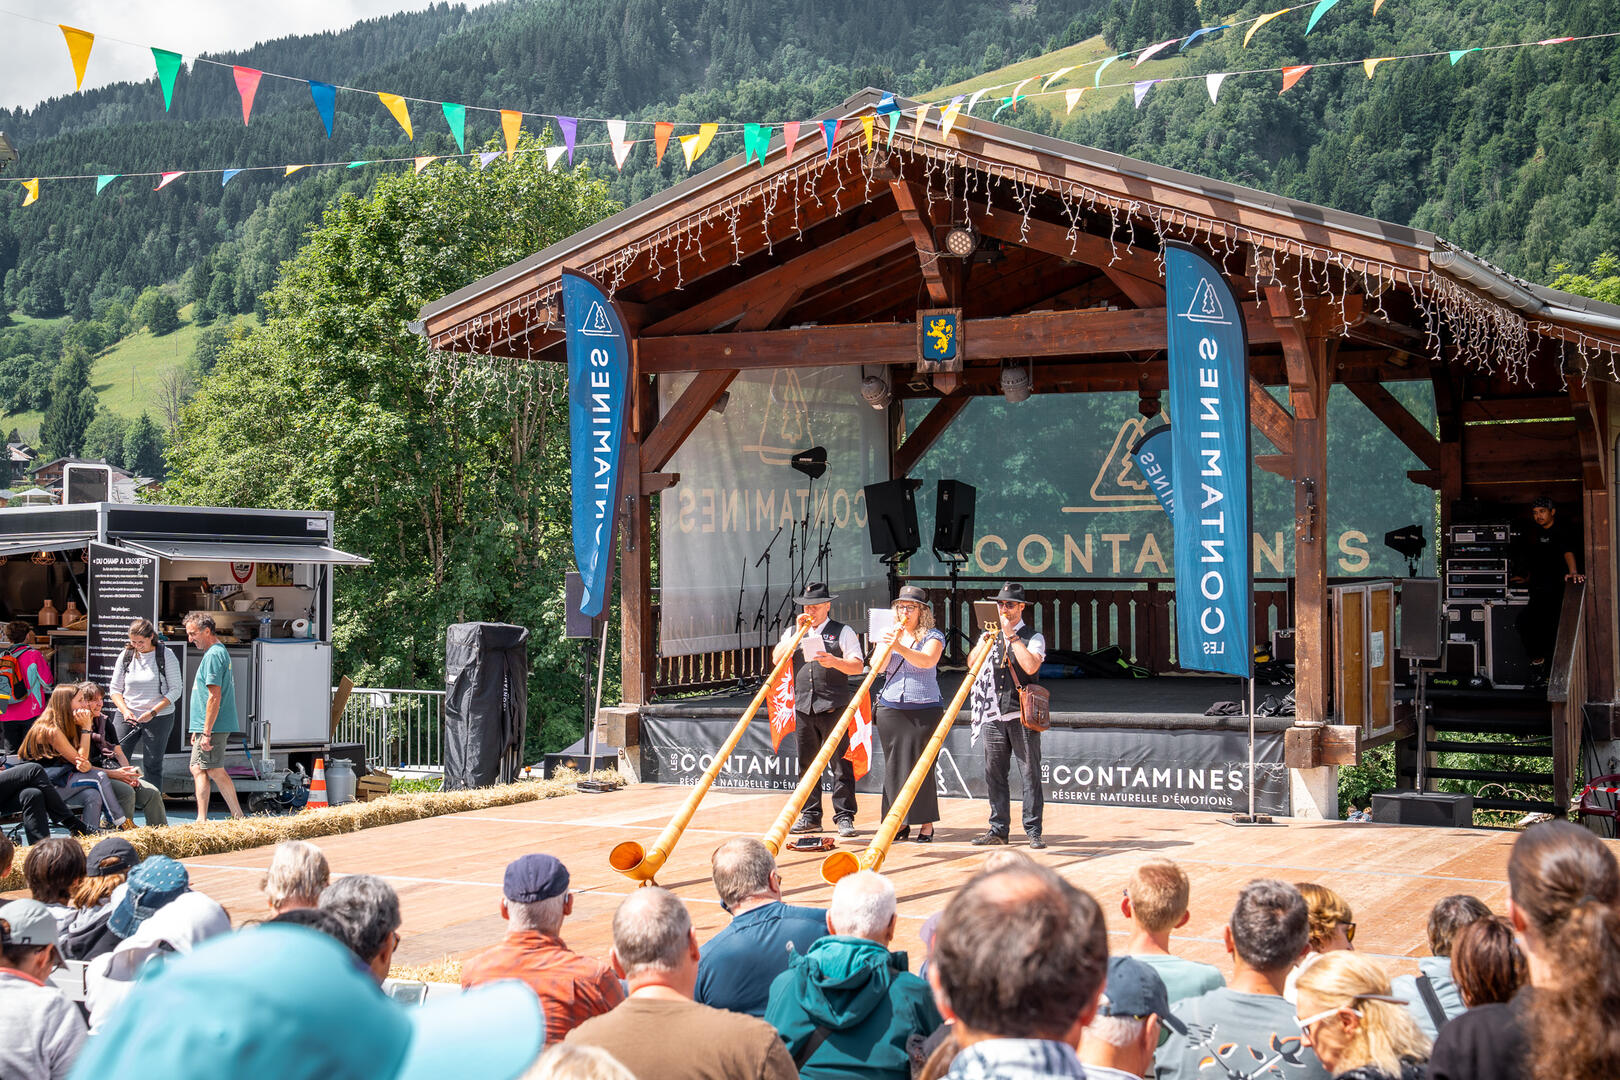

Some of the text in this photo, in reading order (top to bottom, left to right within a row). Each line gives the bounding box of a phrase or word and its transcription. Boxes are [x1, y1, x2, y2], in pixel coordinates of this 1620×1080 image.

[974, 530, 1370, 574] CONTANS
[720, 779, 769, 789] NATURELLE
[1041, 764, 1244, 791] LES CONTAMINES
[1052, 790, 1233, 806] RÉSERVE NATURELLE D'ÉMOTIONS
